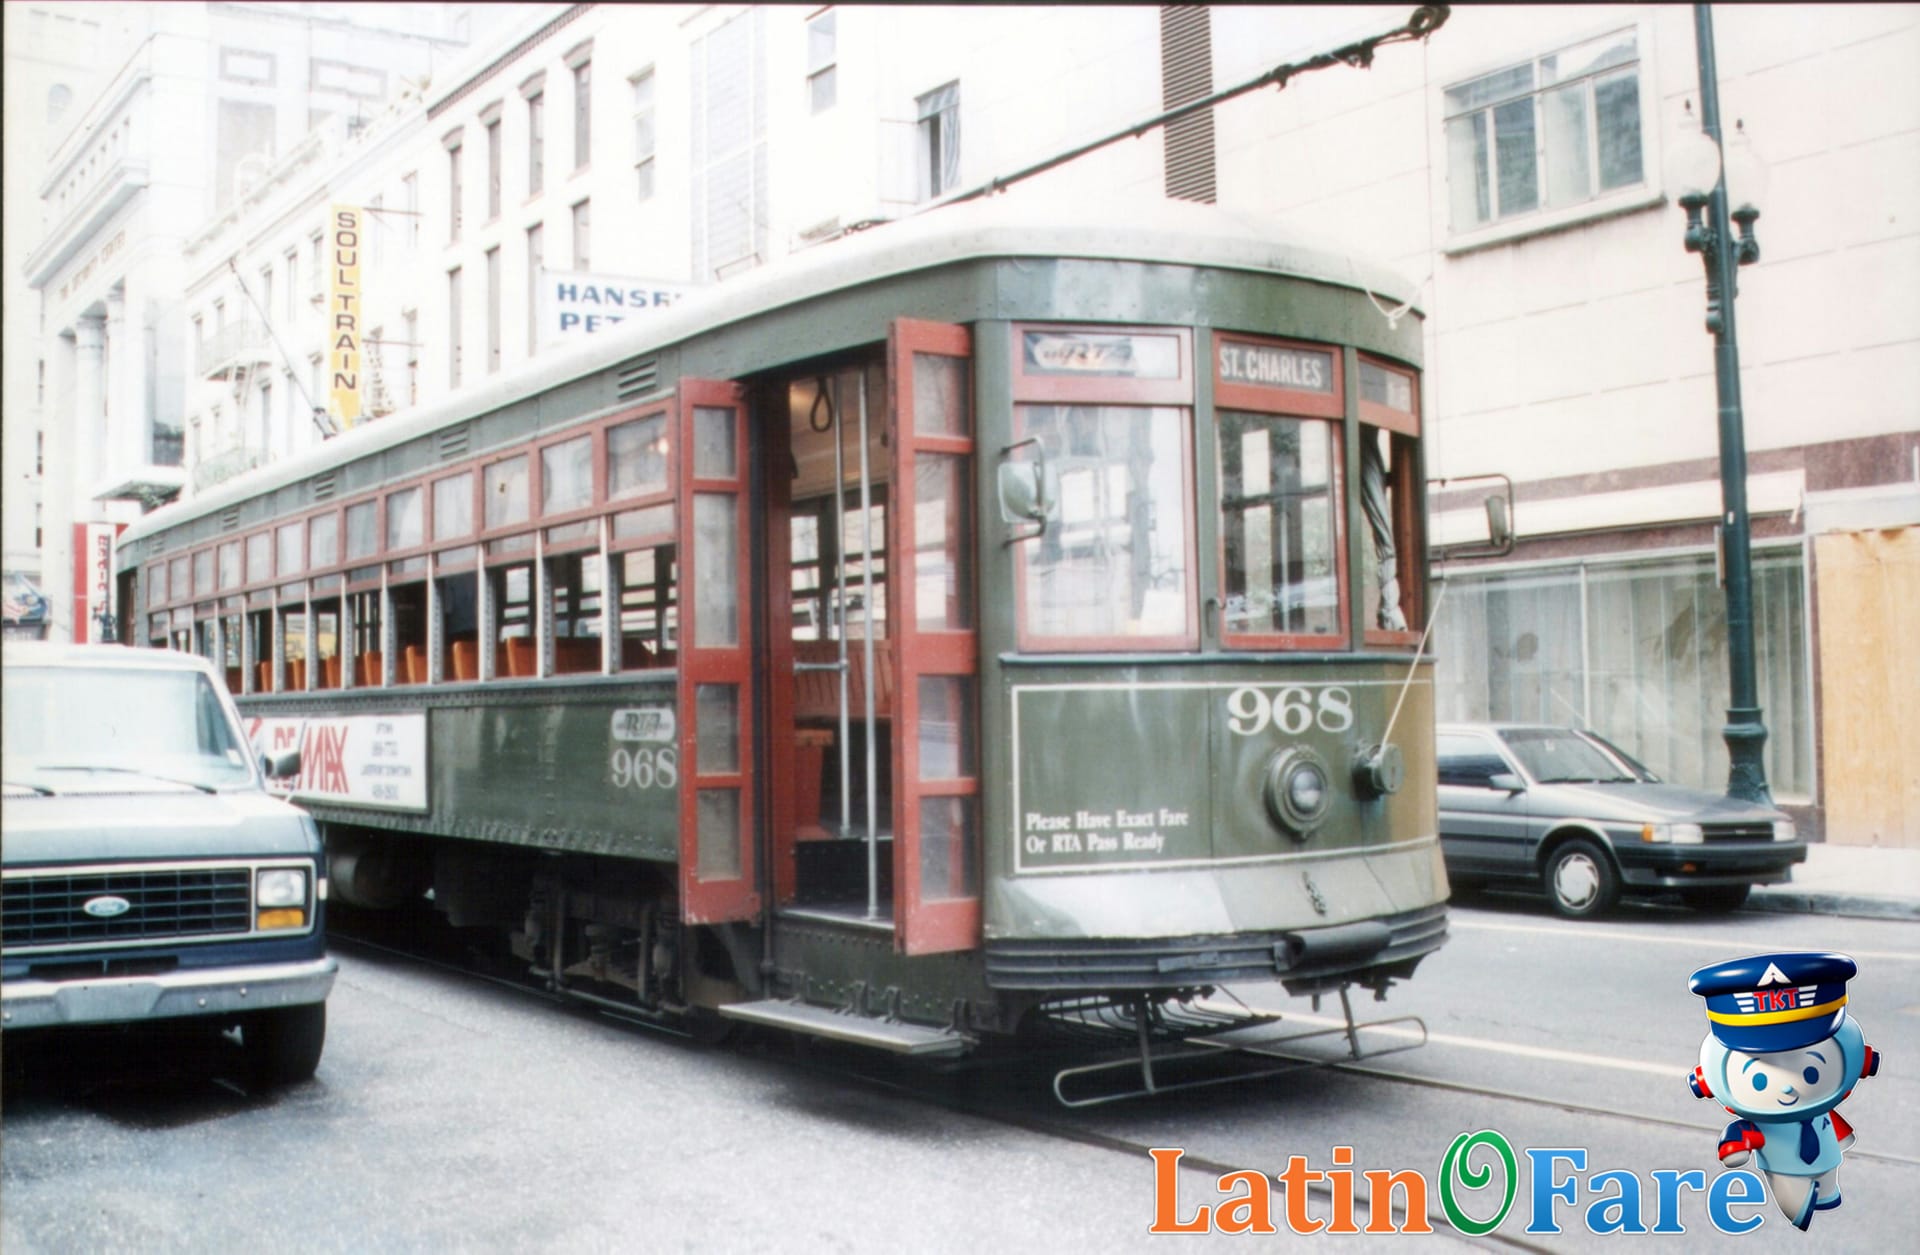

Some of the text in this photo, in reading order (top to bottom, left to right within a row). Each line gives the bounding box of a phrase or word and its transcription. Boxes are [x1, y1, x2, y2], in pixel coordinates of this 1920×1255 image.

[334, 212, 357, 390] SOUL TRAIN
[1220, 343, 1322, 388] ST. CHARLES
[1227, 686, 1353, 736] 968
[611, 748, 677, 789] 968
[1025, 808, 1188, 831] Please Have Exact Fare
[1026, 832, 1165, 854] Or RTA Pass Ready
